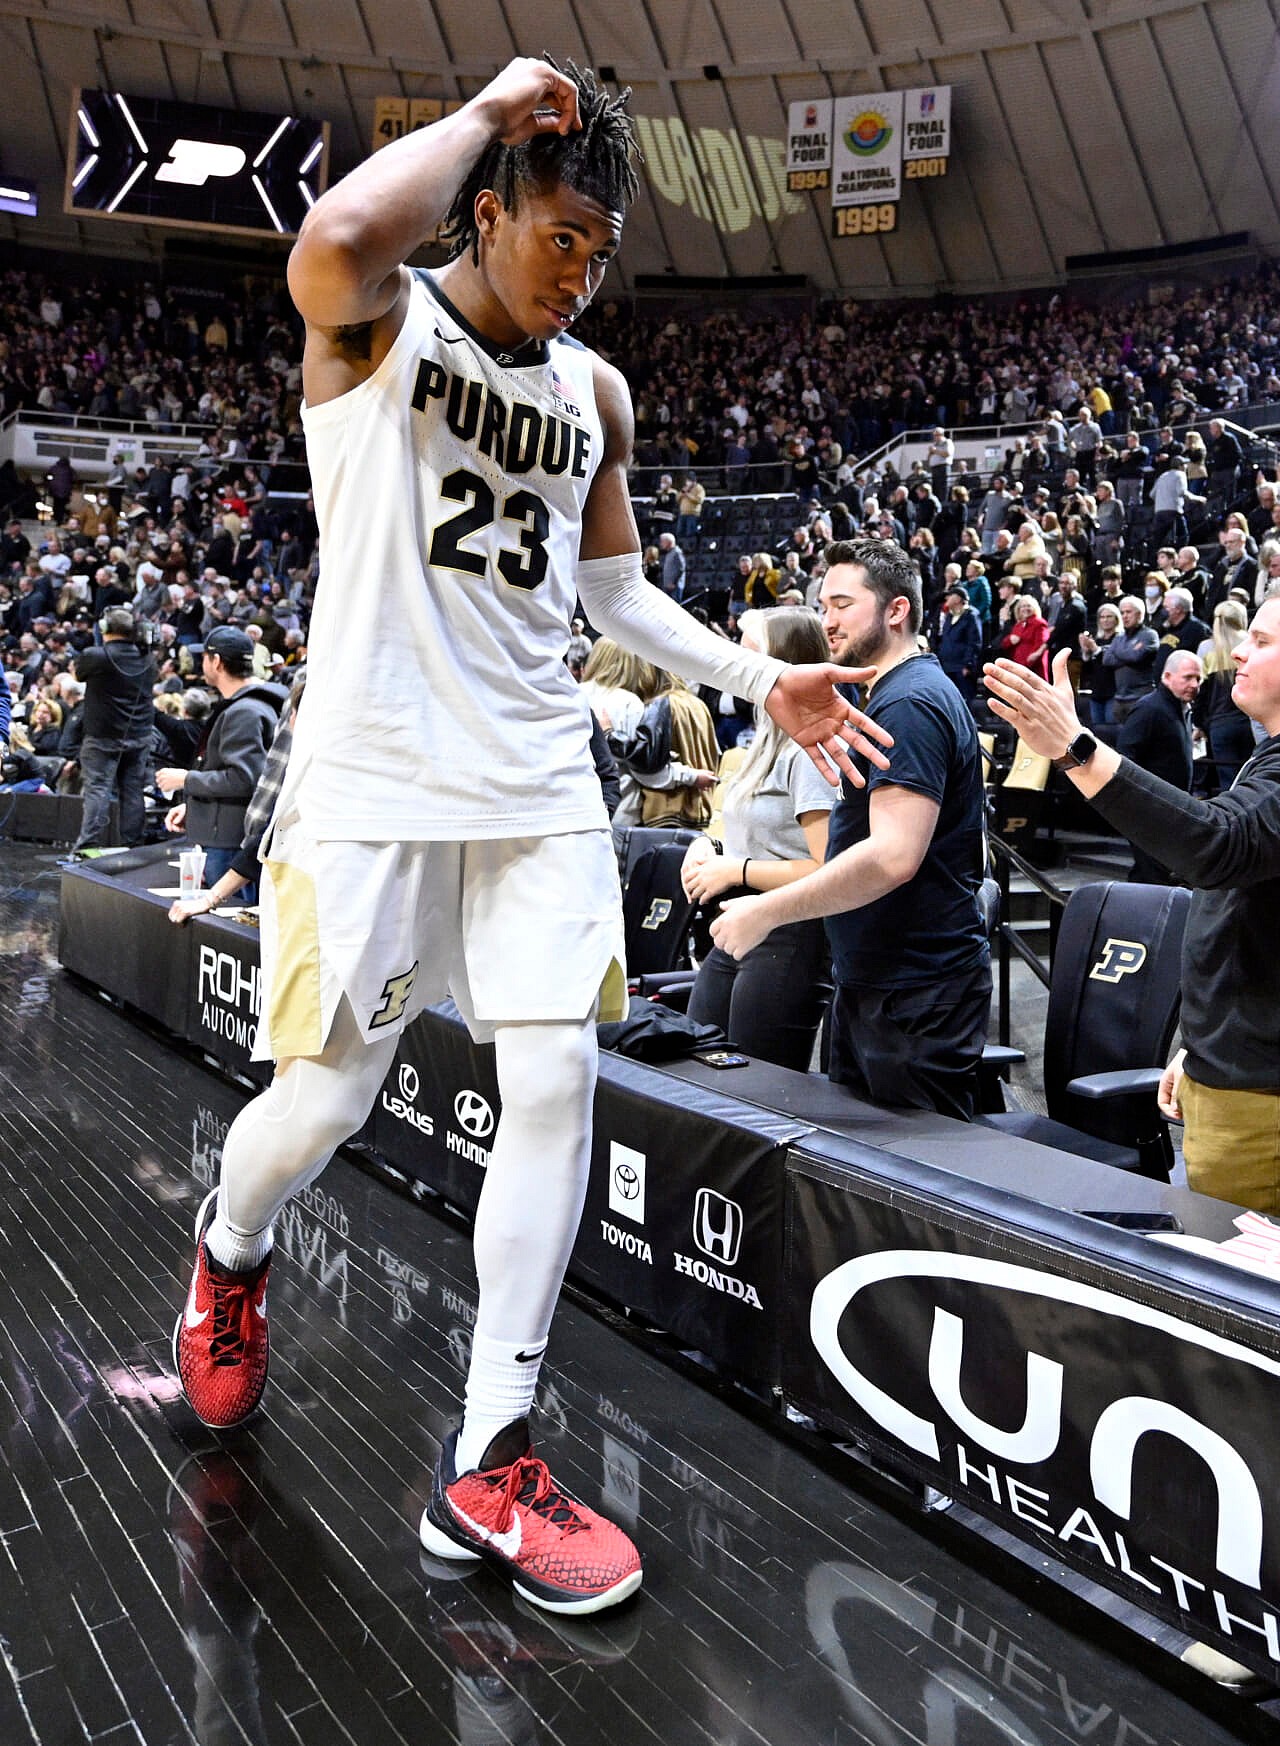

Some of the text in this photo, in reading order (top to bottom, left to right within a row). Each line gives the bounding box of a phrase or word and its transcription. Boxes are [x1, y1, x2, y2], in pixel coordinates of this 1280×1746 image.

[791, 133, 828, 148] FINAL
[907, 120, 946, 136] FINAL
[909, 135, 944, 150] FOUR
[792, 148, 825, 162] FOUR
[905, 159, 947, 178] 2001
[634, 114, 807, 233] URDUE
[789, 171, 828, 189] 1994
[836, 178, 896, 194] CHAMPIONS
[841, 168, 891, 181] NATIONAL
[836, 204, 896, 236] 1999
[411, 357, 591, 479] PURDUE
[428, 469, 550, 591] 23
[1089, 938, 1147, 984] P
[382, 1090, 434, 1136] LEXUS
[446, 1130, 492, 1168] HYUND
[600, 1220, 653, 1265] TOYOTA
[673, 1252, 764, 1311] HONDA
